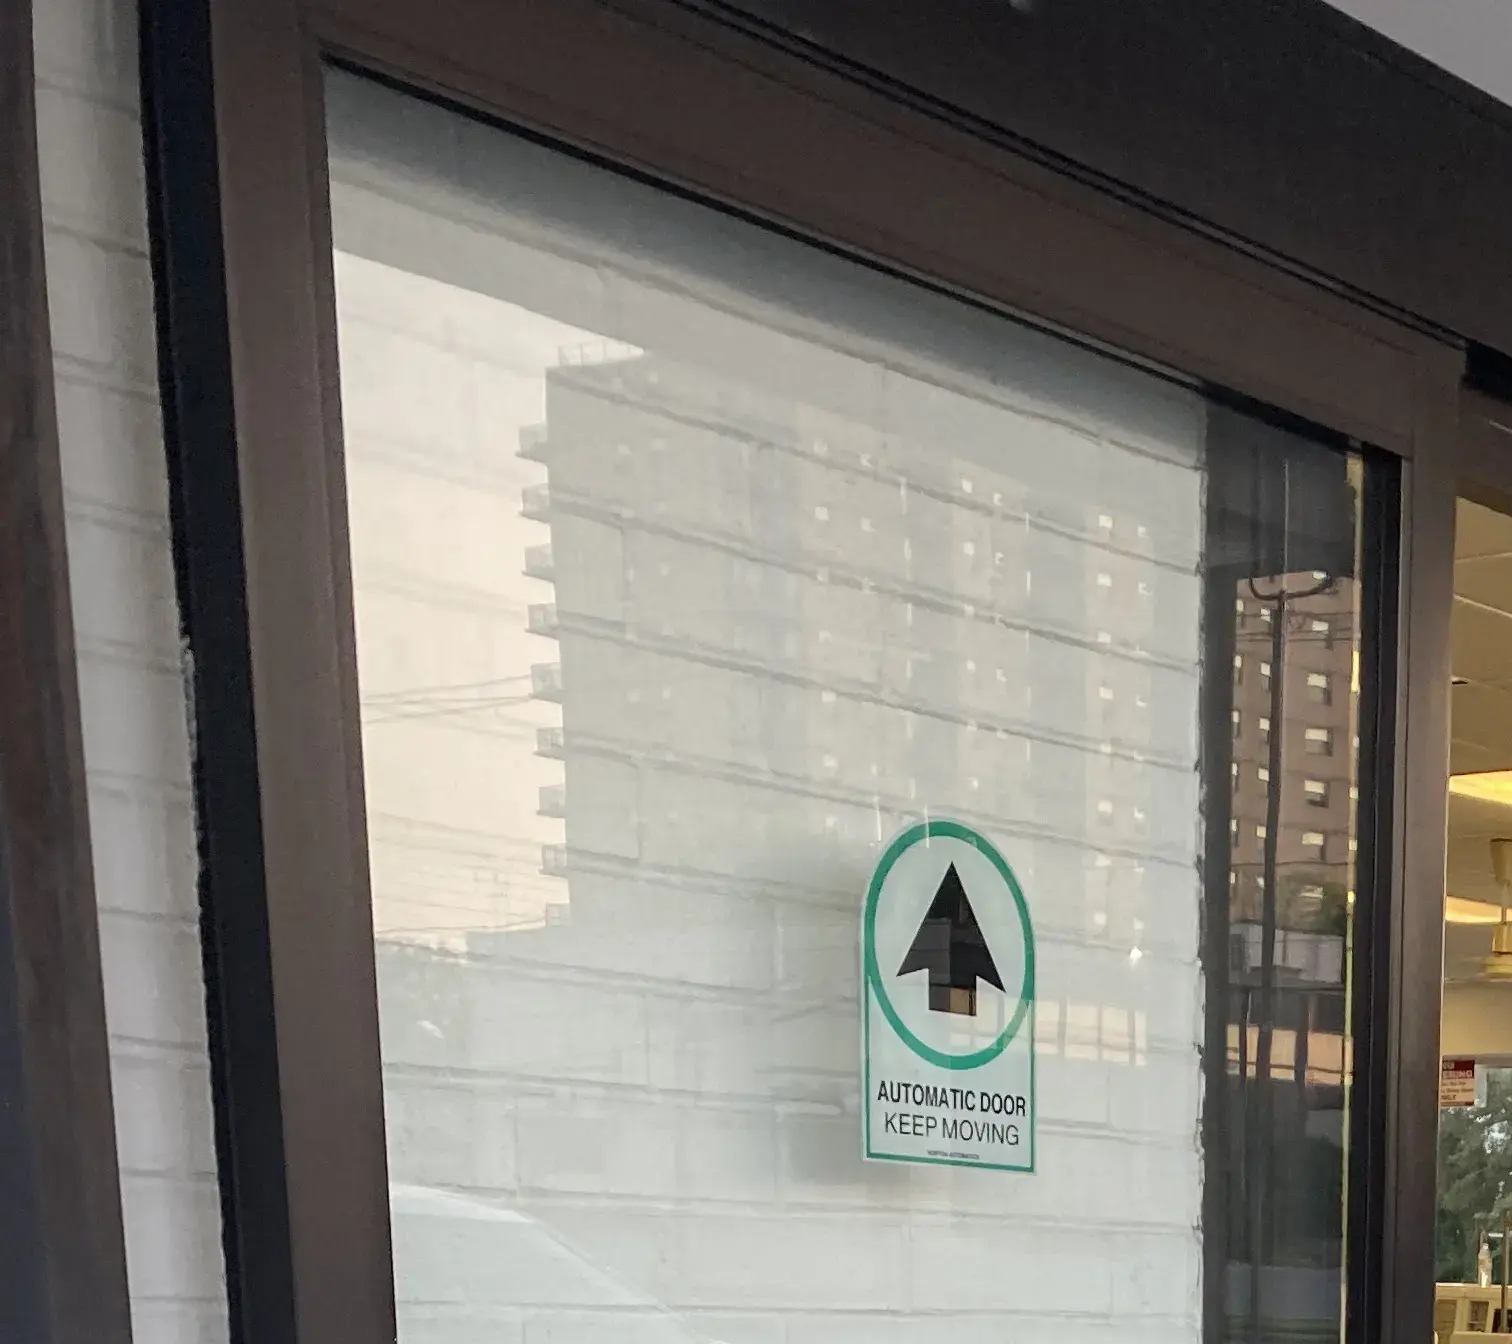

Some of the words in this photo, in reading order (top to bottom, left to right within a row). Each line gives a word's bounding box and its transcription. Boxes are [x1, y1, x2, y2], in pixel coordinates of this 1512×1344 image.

[877, 1080, 976, 1111] AUTOMATIC
[980, 1092, 1026, 1117] DOOR
[885, 1112, 938, 1137] KEEP
[942, 1117, 1020, 1146] MOVING
